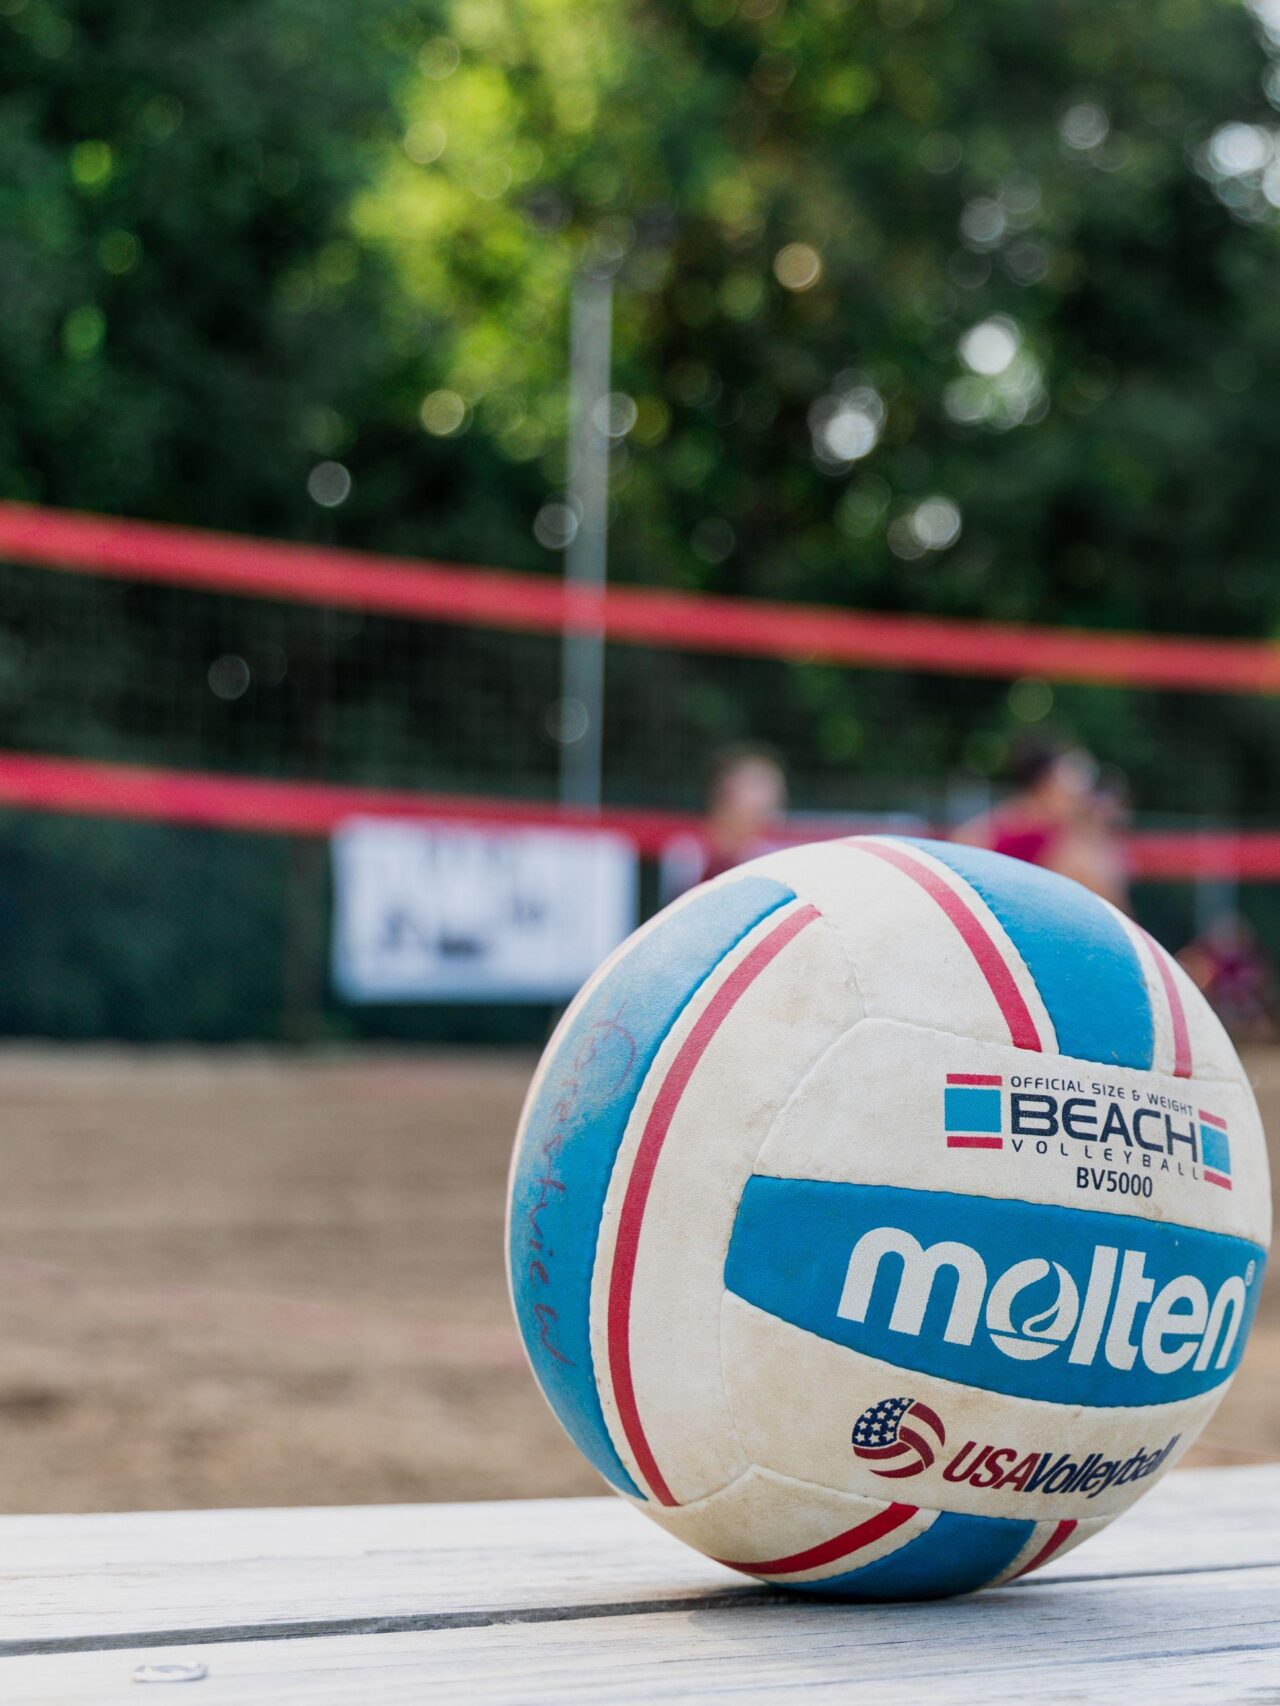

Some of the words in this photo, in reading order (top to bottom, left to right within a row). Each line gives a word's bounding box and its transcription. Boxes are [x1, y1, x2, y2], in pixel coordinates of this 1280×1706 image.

[1010, 1075, 1085, 1093] OFFICIAL
[1091, 1083, 1126, 1099] SIZE
[1132, 1089, 1141, 1102] &
[1146, 1092, 1193, 1117] WEIGHT
[1010, 1092, 1198, 1163] BEACH
[1011, 1139, 1200, 1181] VOLLEYBALL
[1075, 1166, 1153, 1198] BV5000
[836, 1226, 1247, 1375] molten
